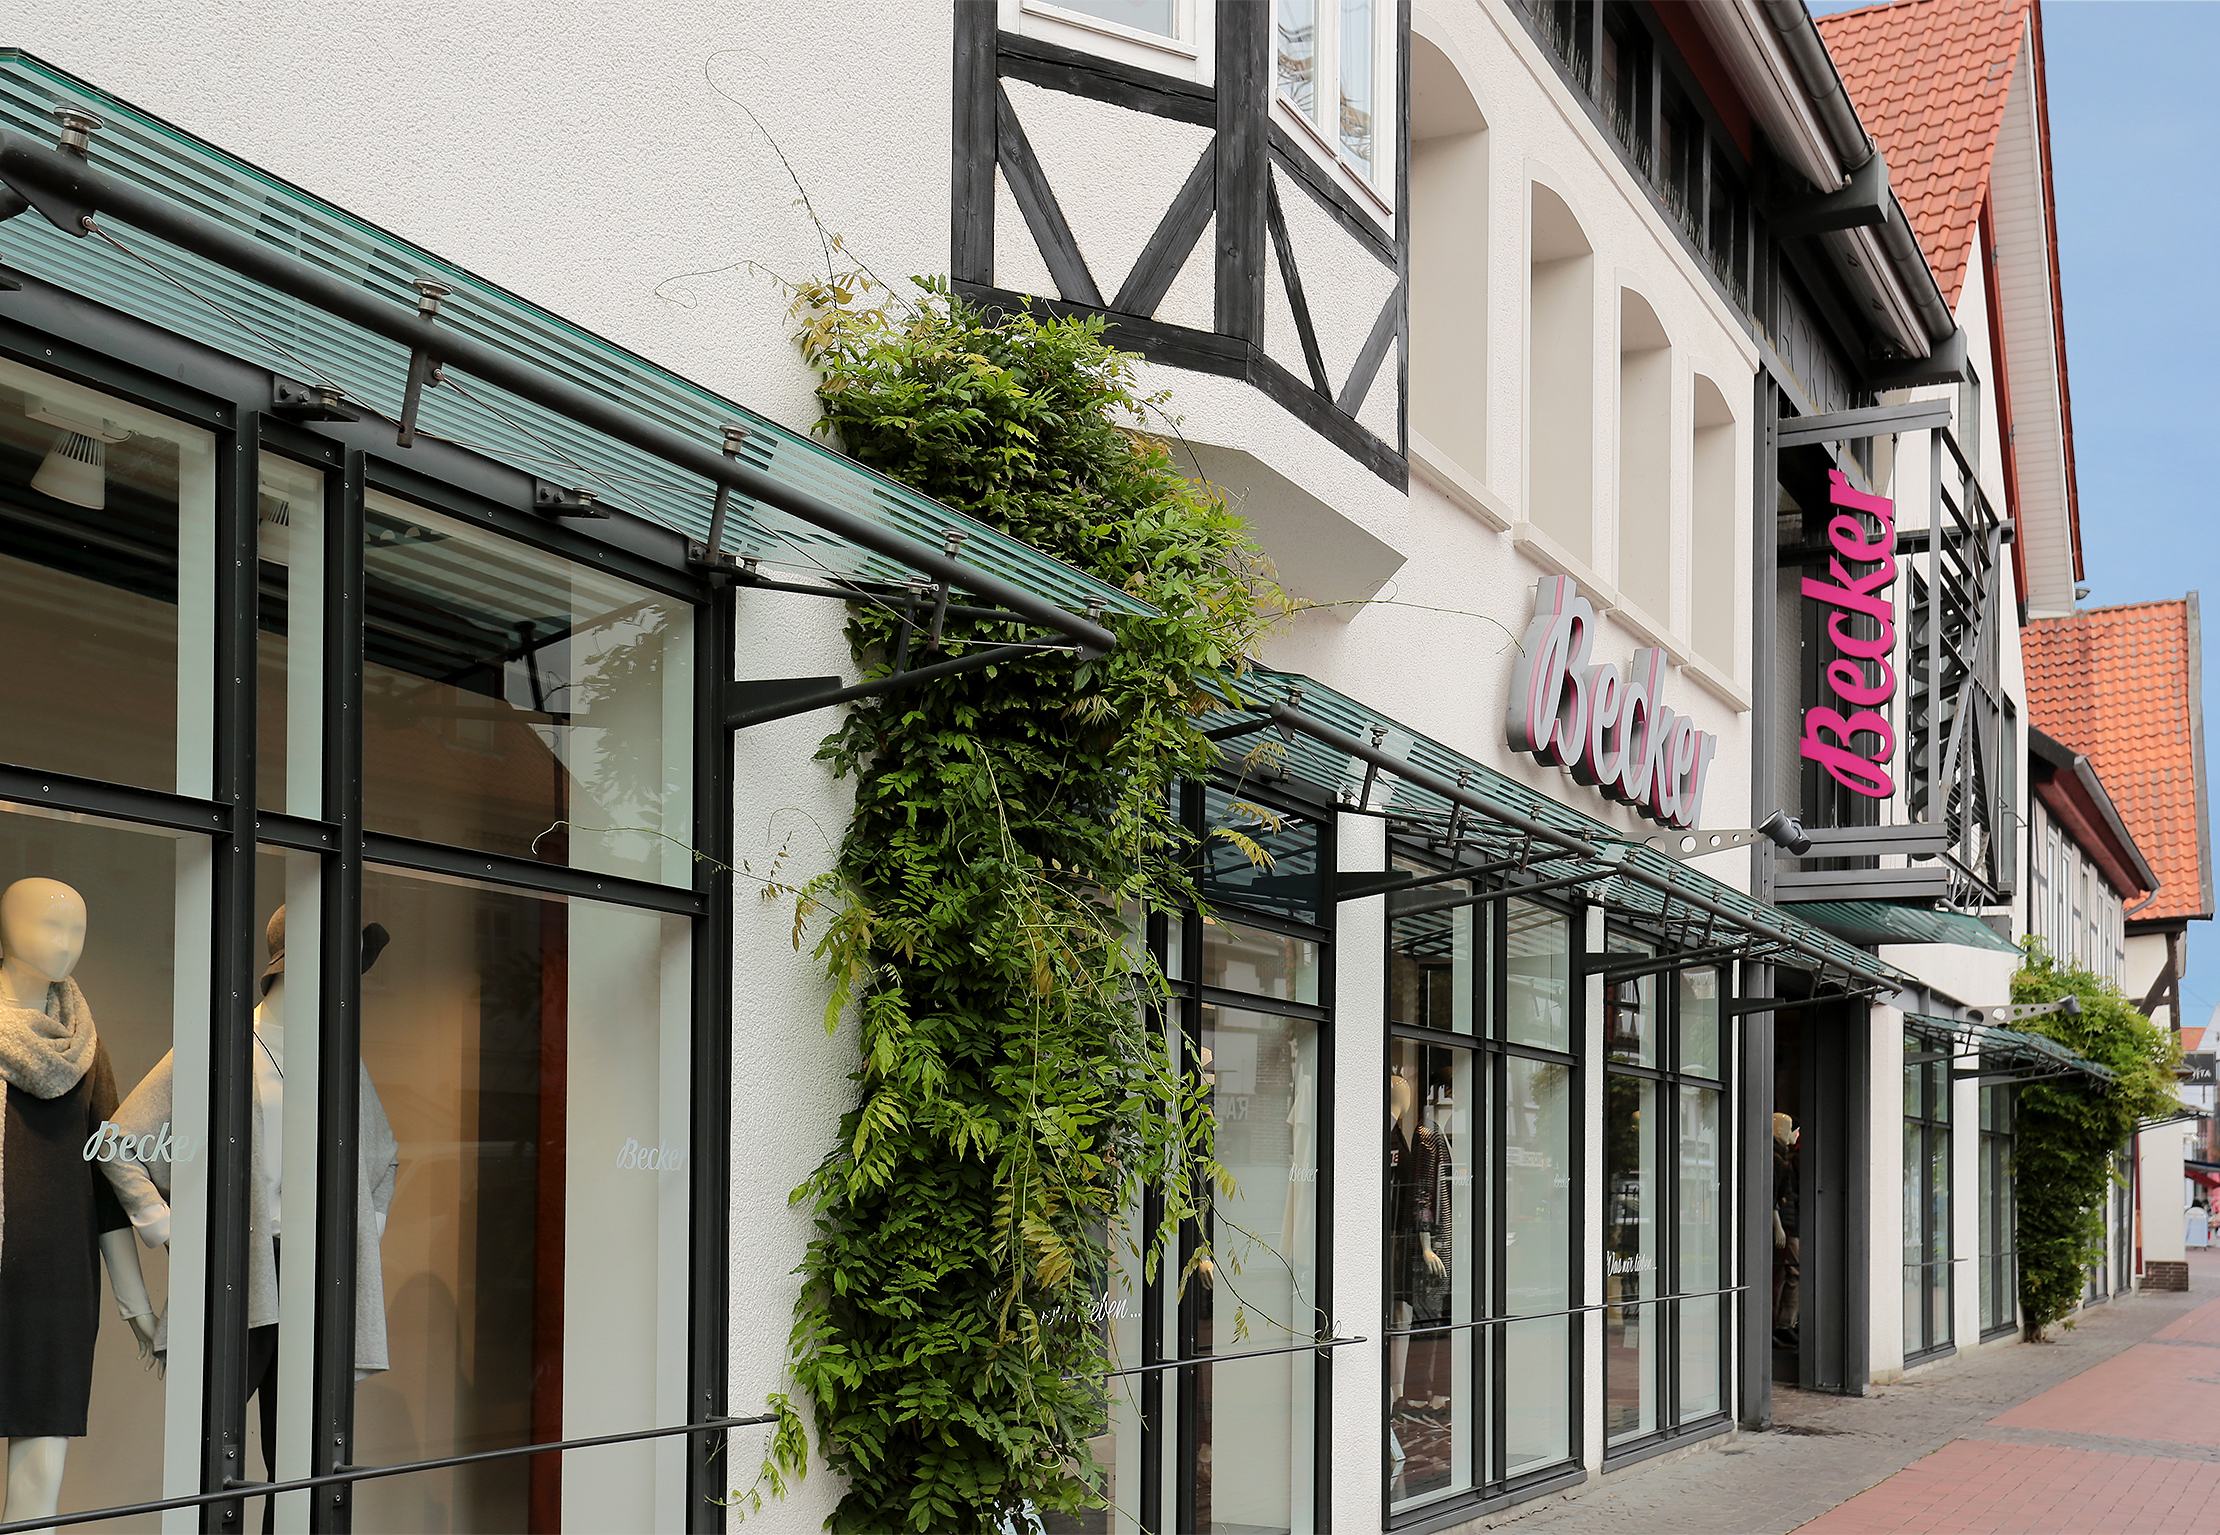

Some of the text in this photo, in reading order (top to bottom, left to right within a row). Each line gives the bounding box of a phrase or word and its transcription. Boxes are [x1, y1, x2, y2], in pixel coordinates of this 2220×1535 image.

[1507, 575, 1717, 830] Becker
[1801, 468, 1898, 800] Becker
[616, 1137, 688, 1171] Becker
